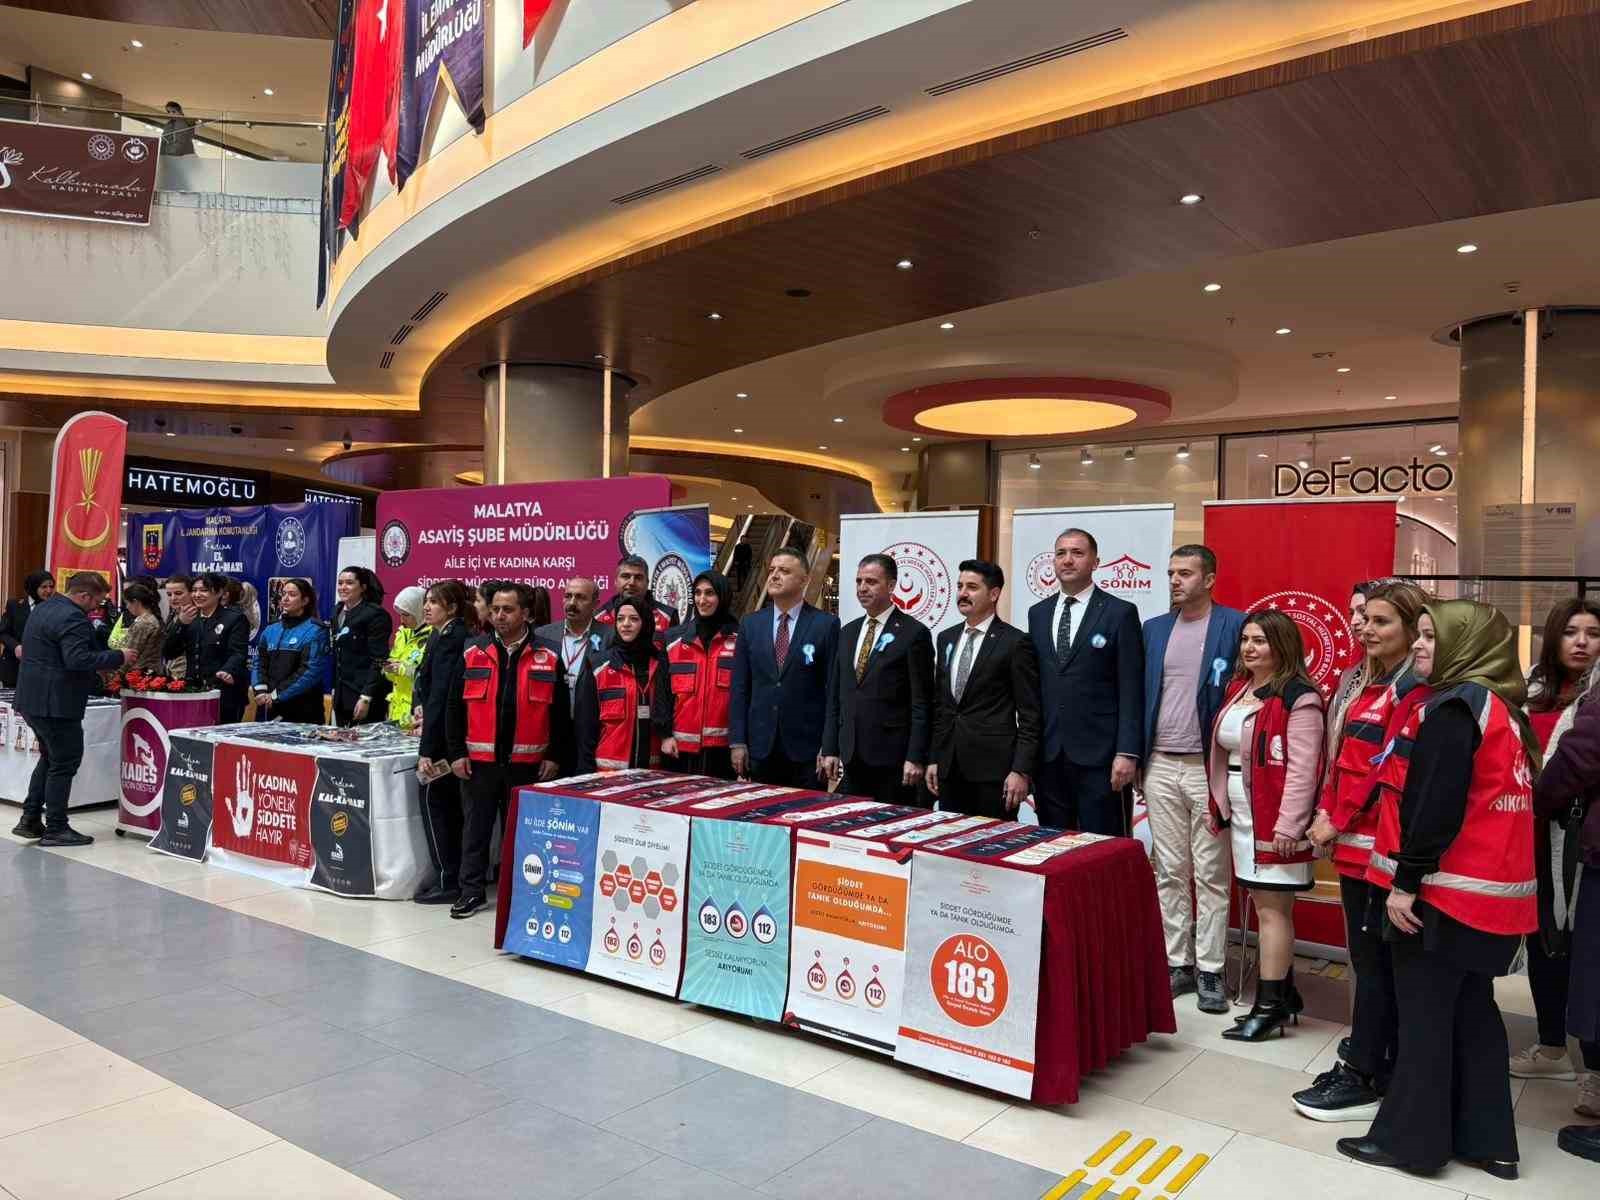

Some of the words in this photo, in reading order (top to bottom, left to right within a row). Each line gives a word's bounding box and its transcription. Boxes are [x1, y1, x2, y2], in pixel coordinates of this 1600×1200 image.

[421, 11, 431, 38] İL
[415, 0, 481, 77] MÜDÜRLÜĞÜ
[128, 472, 256, 499] HATEMOĞLU
[1274, 457, 1453, 497] DeFacto
[474, 501, 543, 519] MALATYA
[418, 524, 465, 547] ASAYİŞ
[468, 527, 506, 547] ŞUBE
[509, 520, 609, 542] MÜDÜRLÜĞÜ
[444, 554, 467, 569] AİLE
[468, 554, 481, 571] İÇİ
[483, 557, 497, 569] VE
[499, 556, 541, 569] KADINA
[543, 555, 576, 571] KARŞI
[524, 575, 556, 590] BÜRO
[121, 761, 157, 785] KADES
[258, 774, 298, 795] KADINA
[257, 790, 296, 813] YÖNELİK
[255, 827, 282, 845] HAYIR
[703, 913, 717, 927] 183
[758, 922, 771, 936] 112
[561, 930, 570, 939] 112
[653, 947, 662, 959] 112
[954, 940, 989, 962] ALO
[810, 973, 824, 985] 183
[943, 960, 996, 1004] 183
[869, 987, 882, 1000] 112
